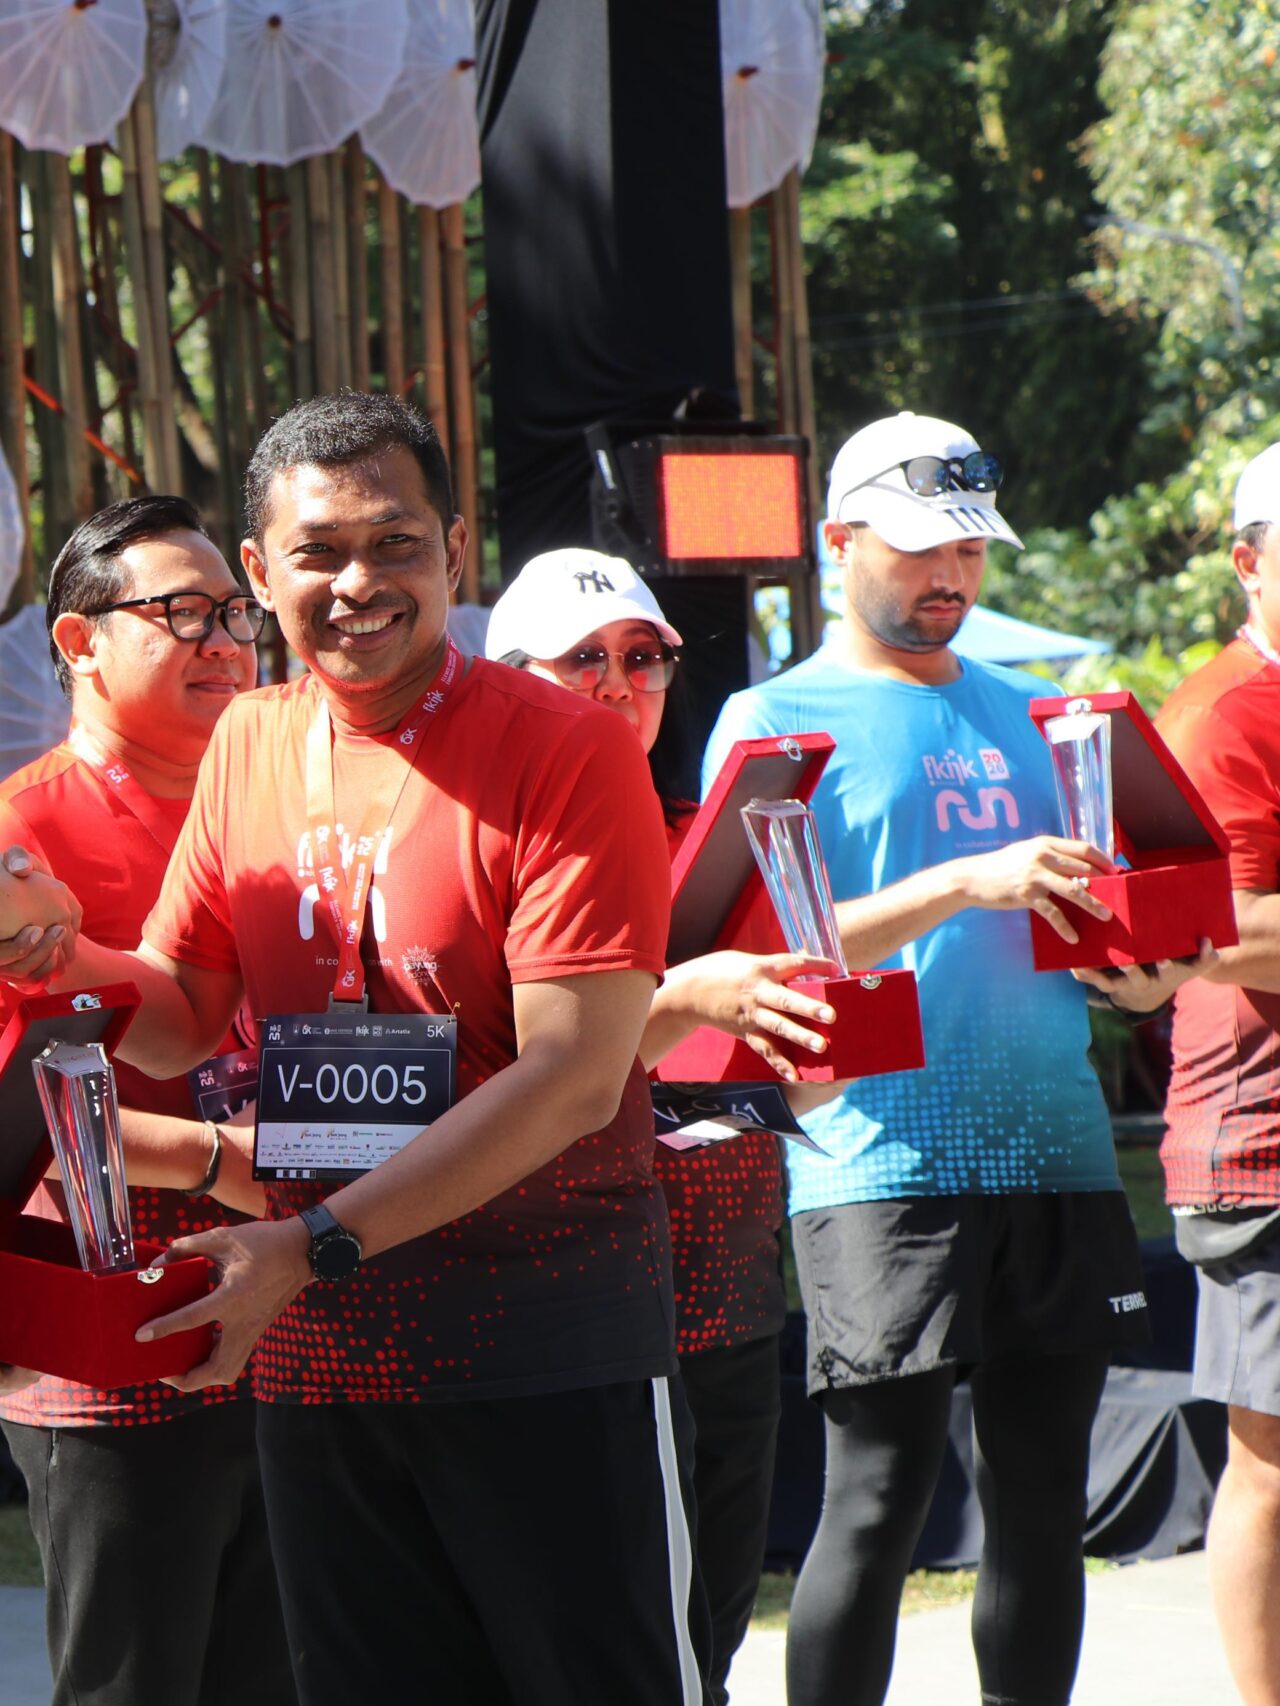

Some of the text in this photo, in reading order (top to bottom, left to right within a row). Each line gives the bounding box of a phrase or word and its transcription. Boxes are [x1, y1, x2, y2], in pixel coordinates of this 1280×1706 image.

[315, 954, 326, 966] in
[426, 1025, 445, 1038] 5K
[277, 1063, 427, 1105] V-0005
